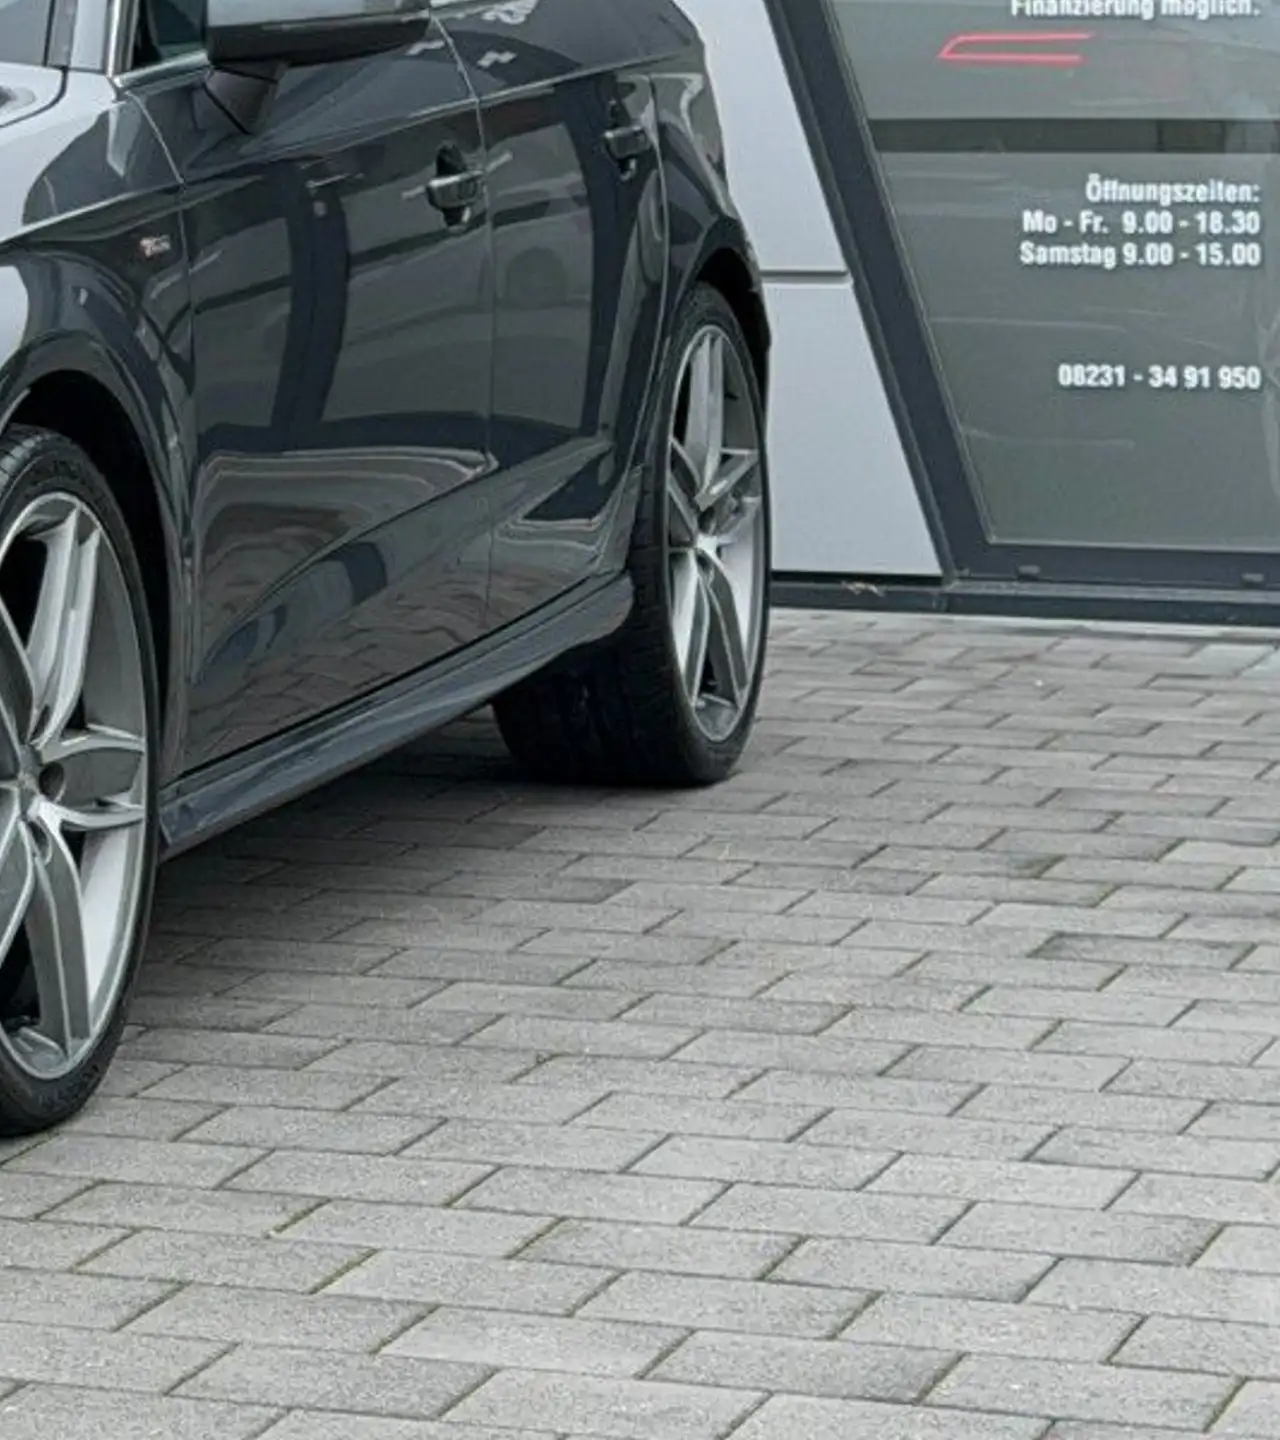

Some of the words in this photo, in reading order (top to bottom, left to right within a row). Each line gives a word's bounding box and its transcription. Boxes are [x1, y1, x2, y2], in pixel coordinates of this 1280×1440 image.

[1086, 173, 1260, 207] Öffnungszeiten:
[1022, 210, 1057, 233] Mo
[1079, 210, 1109, 233] Fr.
[1122, 210, 1173, 234] 9.00
[1195, 210, 1260, 234] 18.30
[1020, 240, 1117, 269] Samstag
[1122, 243, 1174, 266] 9.00
[1195, 242, 1261, 266] 15.00
[1058, 364, 1125, 388] 08231
[1148, 364, 1178, 388] 34
[1183, 364, 1211, 389] 91
[1218, 365, 1261, 389] 950
